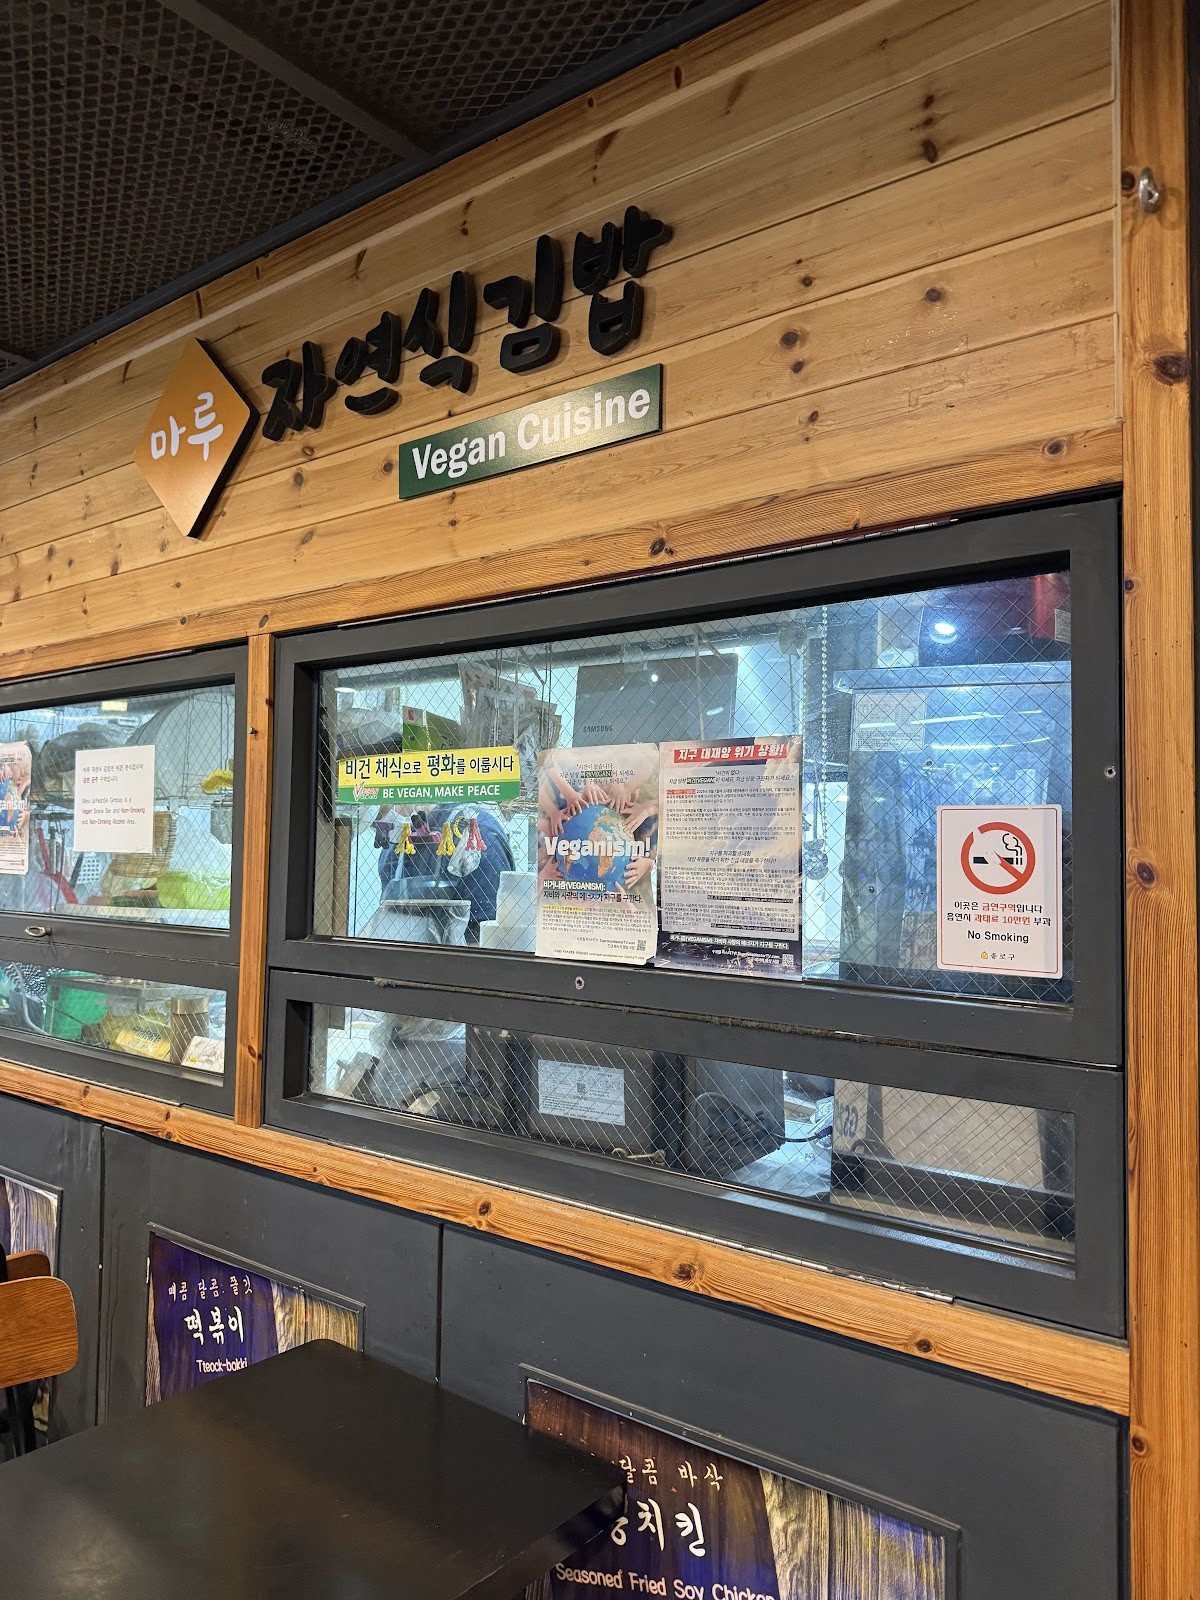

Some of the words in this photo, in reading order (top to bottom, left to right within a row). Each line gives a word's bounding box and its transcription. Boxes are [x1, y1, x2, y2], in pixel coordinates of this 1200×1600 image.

[150, 391, 224, 461] 마루
[411, 428, 506, 480] Vegan
[516, 386, 650, 451] Cuisine
[582, 724, 614, 733] SAMSUNG
[677, 749, 698, 760] 지구
[700, 746, 731, 759] 대재앙
[734, 745, 754, 758] 위기
[757, 744, 785, 757] 상황!
[345, 758, 371, 780] 비건
[375, 757, 422, 778] 채식으로
[427, 753, 466, 777] 평화를
[469, 755, 515, 774] 이룹시다
[382, 788, 394, 799] BE
[397, 787, 433, 799] VEGAN,
[434, 786, 464, 797] MAKE
[467, 785, 500, 796] PEACE
[544, 836, 651, 861] Veganism!
[954, 901, 979, 911] 이곳은
[982, 902, 1043, 914] 금연구역입니다
[946, 912, 971, 922] 흡연시
[974, 913, 999, 923] 과태료
[1002, 916, 1031, 926] 10만원
[1033, 917, 1051, 927] 부과
[967, 930, 981, 940] No
[984, 931, 1029, 944] Smoking
[197, 1278, 220, 1300] 달콤
[184, 1305, 244, 1346] 떡볶이
[618, 1455, 659, 1486] 달콤
[677, 1460, 724, 1492] 바삭
[555, 1562, 624, 1590] Seasoned
[627, 1571, 667, 1597] Fried
[673, 1578, 705, 1600] Soy
